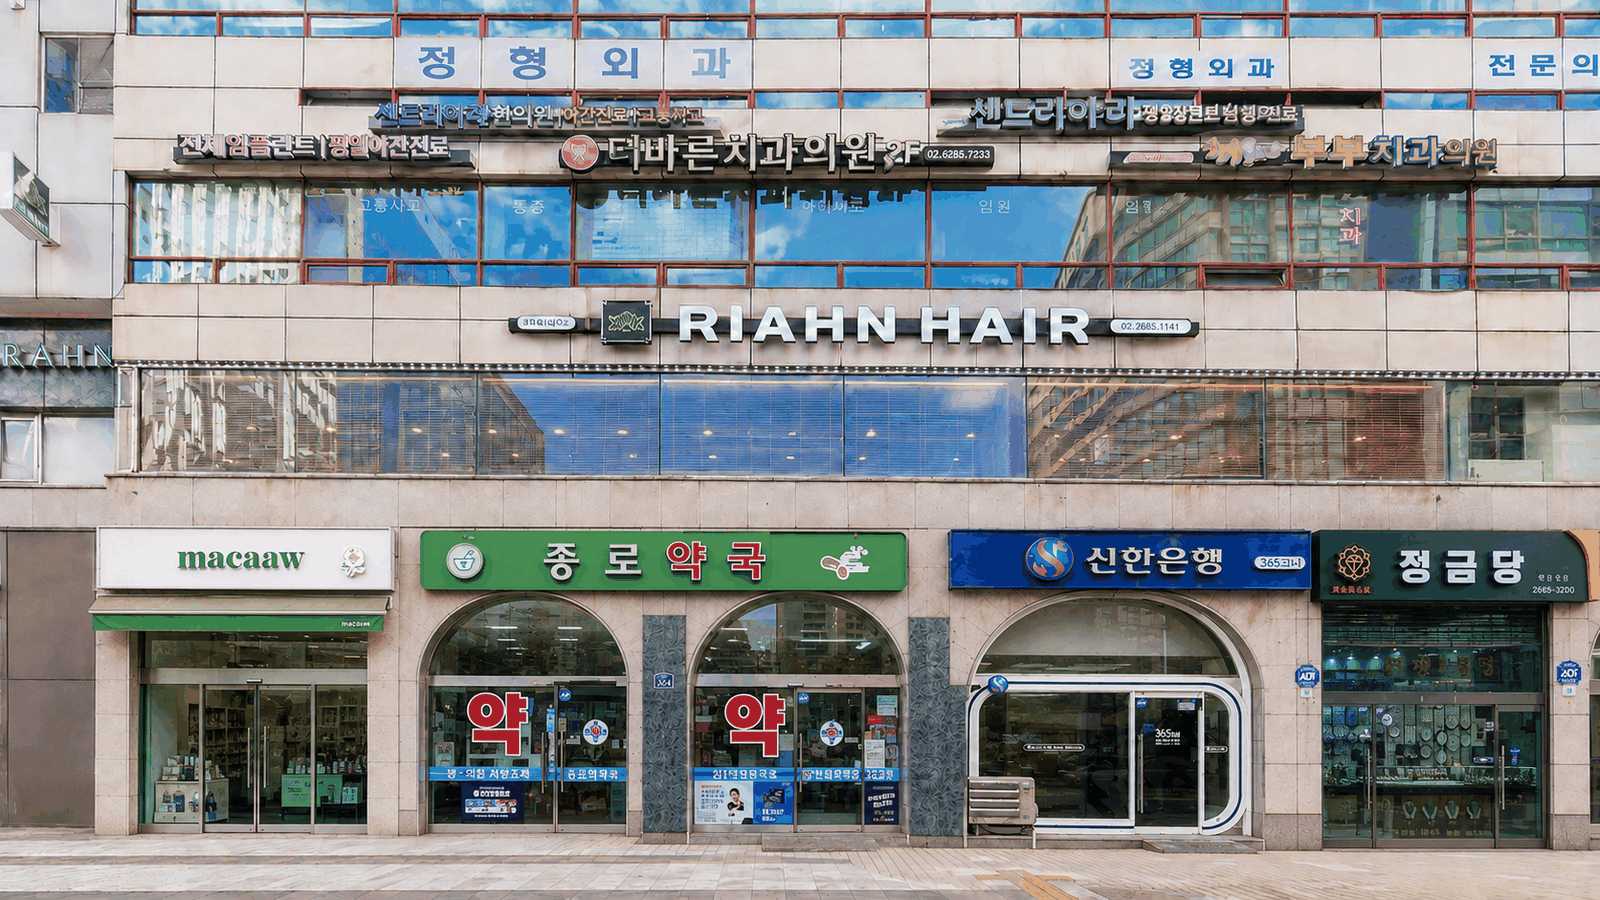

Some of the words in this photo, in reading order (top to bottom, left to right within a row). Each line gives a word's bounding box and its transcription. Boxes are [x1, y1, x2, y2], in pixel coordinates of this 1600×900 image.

[1129, 57, 1275, 80] 정형외과
[607, 133, 875, 173] 더바른치과의원
[927, 150, 991, 159] 02.6285.7233
[1290, 135, 1498, 168] 부부치과의원
[679, 304, 897, 343] RIAHN
[920, 306, 1090, 345] HAIR
[177, 550, 305, 570] macaaw
[543, 541, 768, 582] 종로약국
[1085, 546, 1223, 576] 신한은행
[1400, 550, 1525, 584] 정금당
[467, 692, 529, 757] 약
[724, 693, 787, 758] 약
